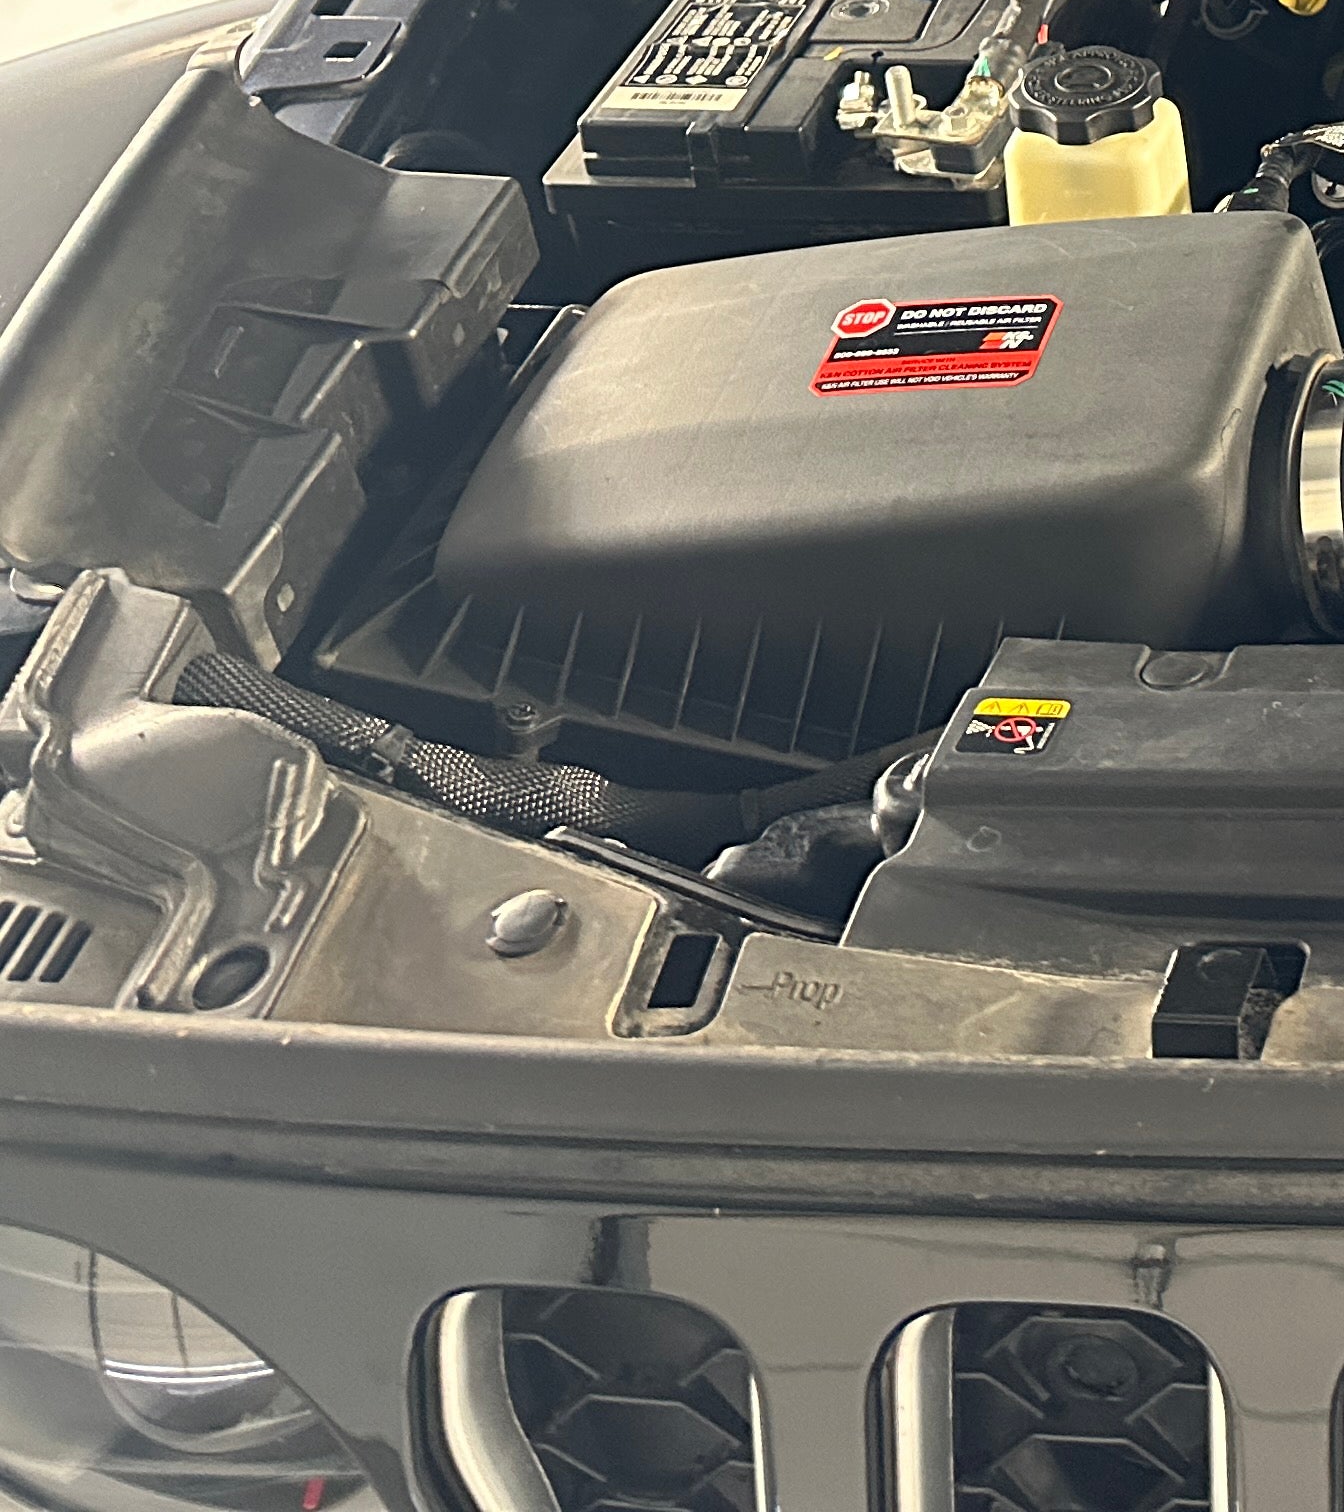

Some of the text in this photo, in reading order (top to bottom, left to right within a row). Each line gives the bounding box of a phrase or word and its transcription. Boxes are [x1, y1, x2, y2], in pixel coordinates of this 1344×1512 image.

[841, 310, 887, 327] STOP
[900, 303, 1048, 320] DO NOT DISCARD
[995, 317, 1012, 325] AIR
[1012, 316, 1043, 324] FILTER
[842, 368, 884, 377] COTTON
[903, 365, 938, 373] FILTER
[941, 362, 989, 370] CLEANING
[990, 360, 1032, 368] SYSTEM
[772, 970, 839, 1010] Prop
